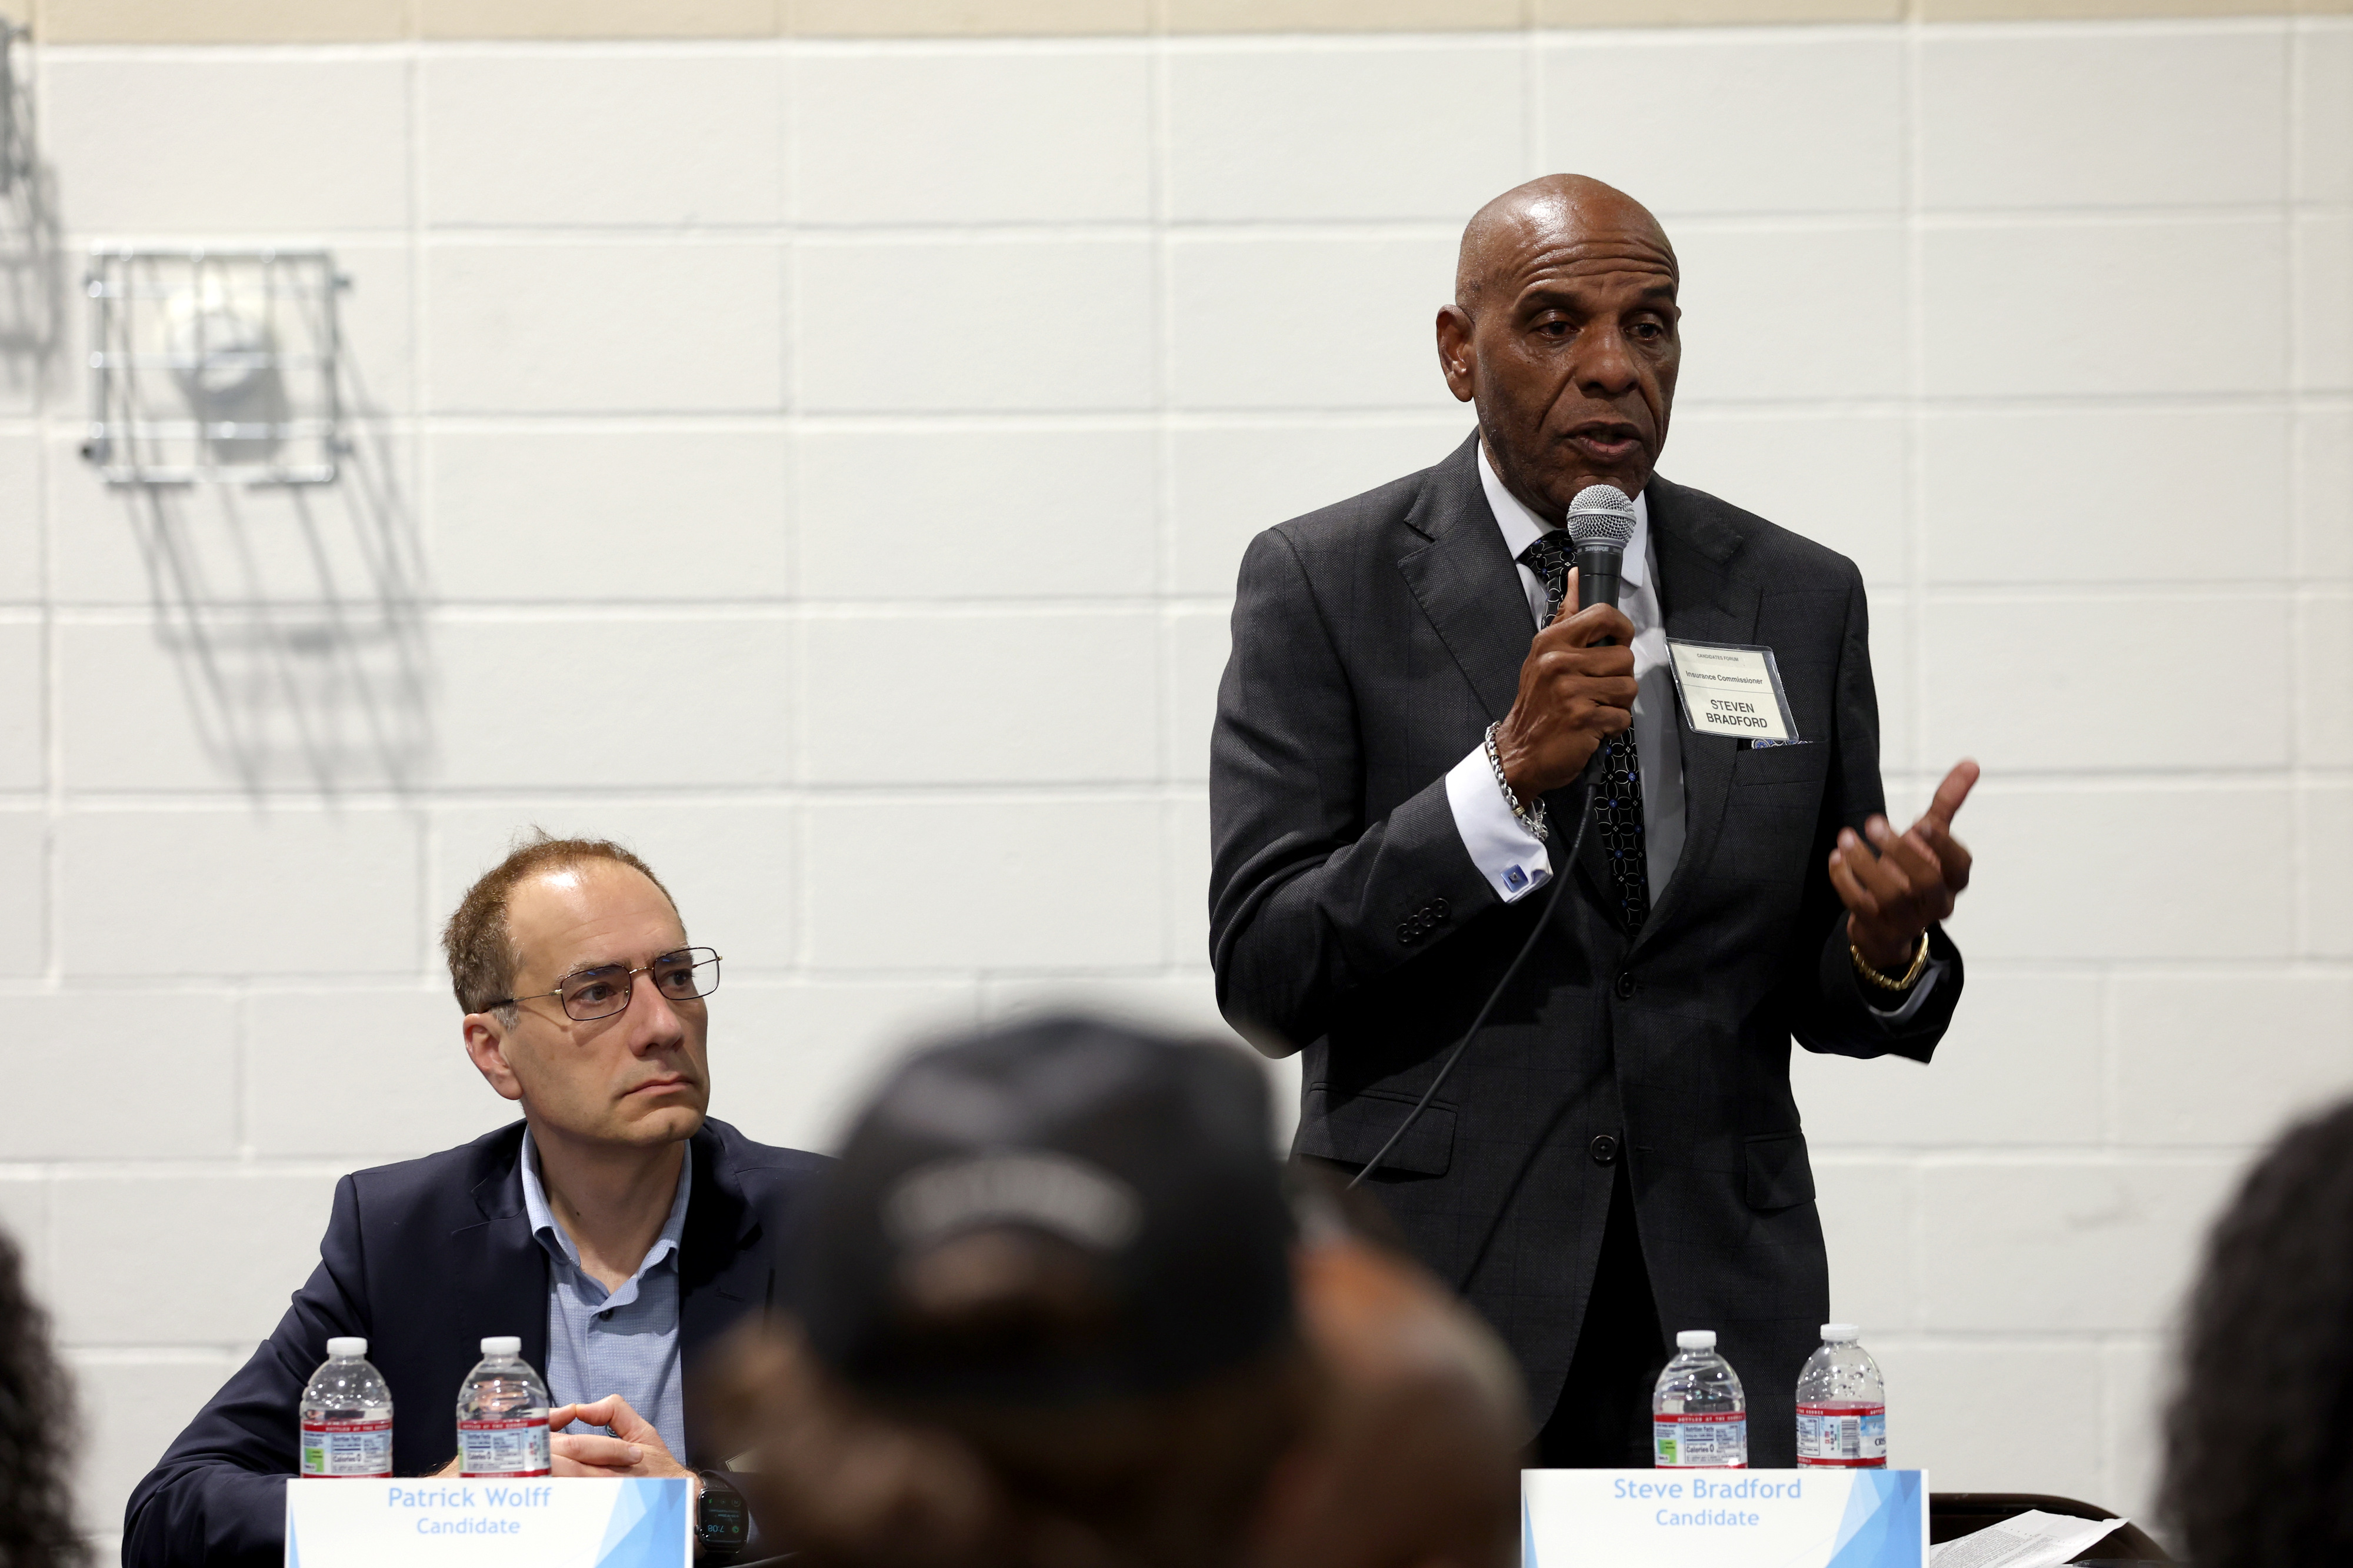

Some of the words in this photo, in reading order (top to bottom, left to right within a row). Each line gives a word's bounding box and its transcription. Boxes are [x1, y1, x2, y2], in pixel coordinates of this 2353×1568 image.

[1686, 670, 1717, 680] Insurance
[1717, 675, 1763, 685] Commissioner
[1711, 699, 1755, 713] STEVEN
[1706, 713, 1768, 728] BRADFORD
[1709, 1444, 1714, 1453] 0
[1614, 1479, 1683, 1499] Steve
[1694, 1478, 1802, 1499] Bradford
[389, 1487, 475, 1507] Patrick
[485, 1486, 552, 1507] Wolff
[1656, 1509, 1759, 1526] Candidate
[416, 1517, 521, 1534] Candidate
[708, 1524, 724, 1533] 7:08
